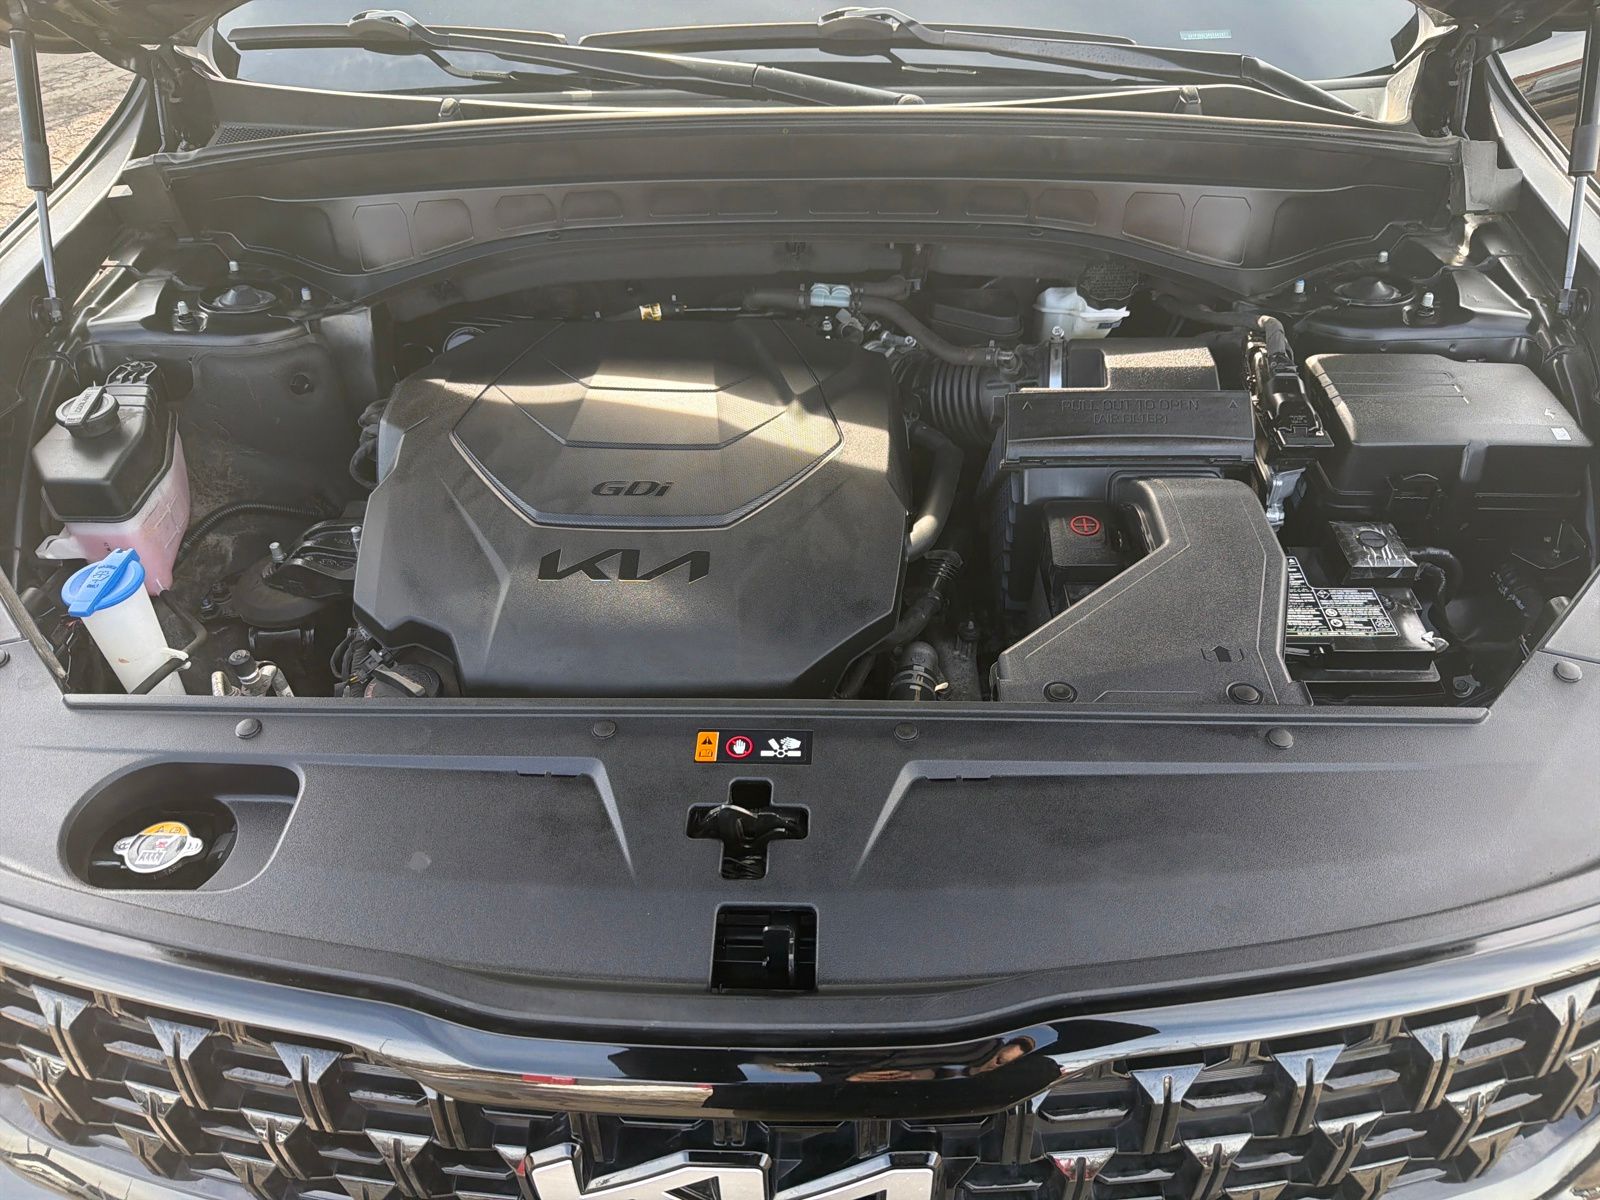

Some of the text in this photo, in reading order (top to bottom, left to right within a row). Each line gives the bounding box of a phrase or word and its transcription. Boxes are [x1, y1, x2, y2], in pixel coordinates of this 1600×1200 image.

[1102, 399, 1132, 411] OUT
[1136, 399, 1156, 411] TO
[1158, 399, 1200, 411] OPEN
[591, 480, 675, 497] GDi
[537, 548, 711, 585] KIA
